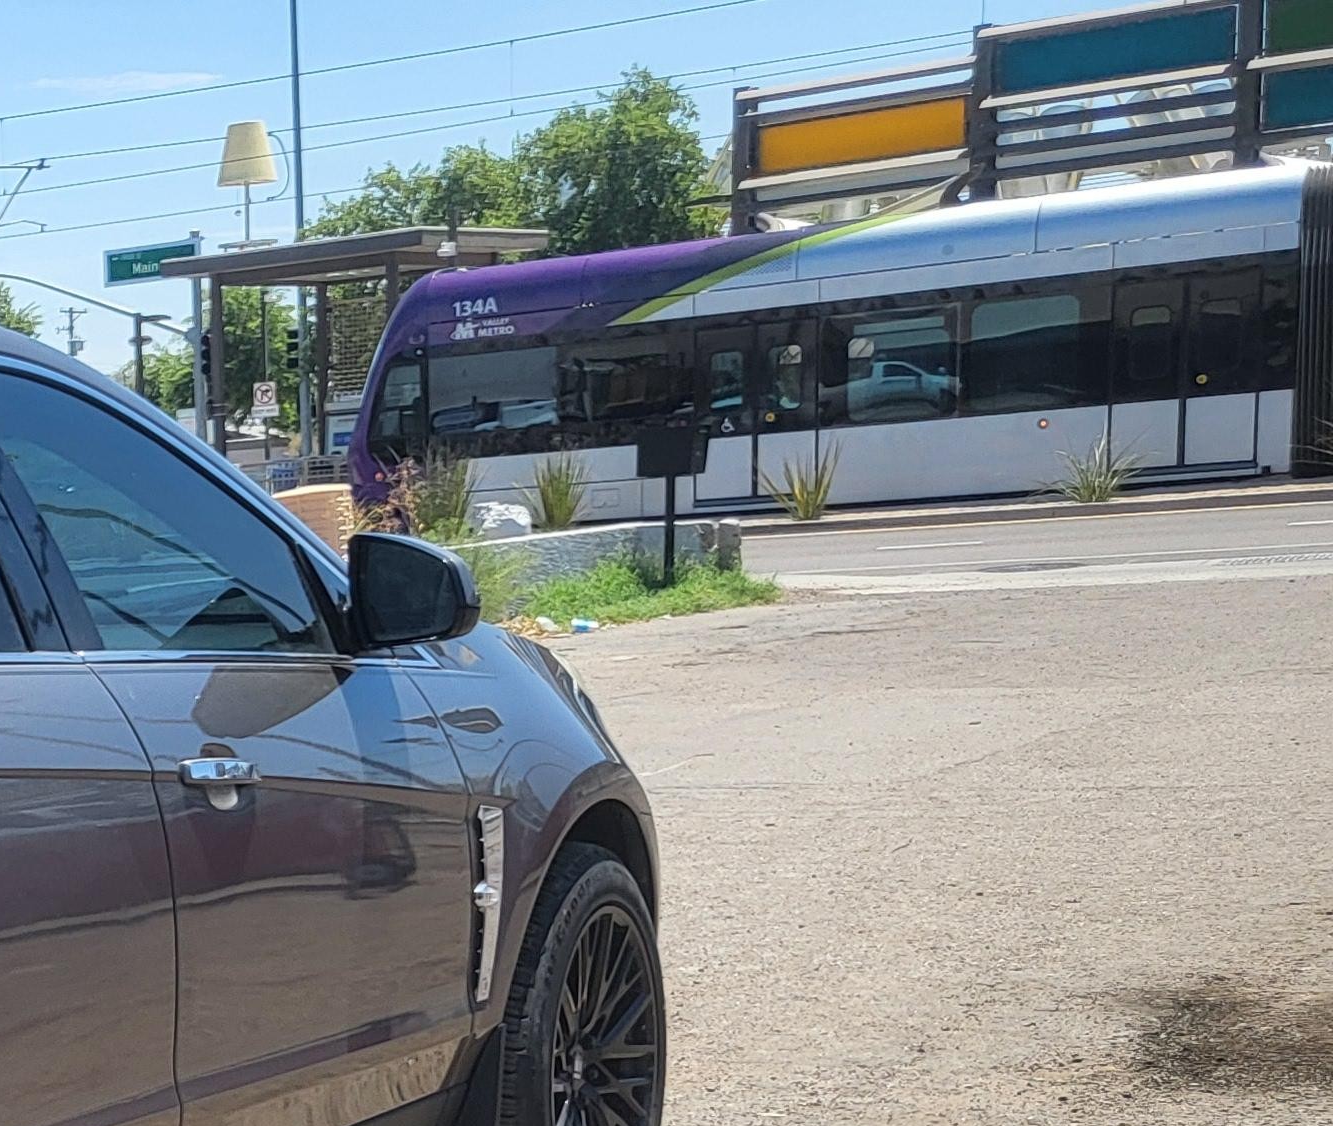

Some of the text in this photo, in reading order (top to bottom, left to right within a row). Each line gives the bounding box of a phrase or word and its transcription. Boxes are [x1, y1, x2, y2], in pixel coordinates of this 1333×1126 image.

[132, 261, 159, 274] Main
[452, 297, 498, 317] 134A
[477, 325, 515, 337] METRO
